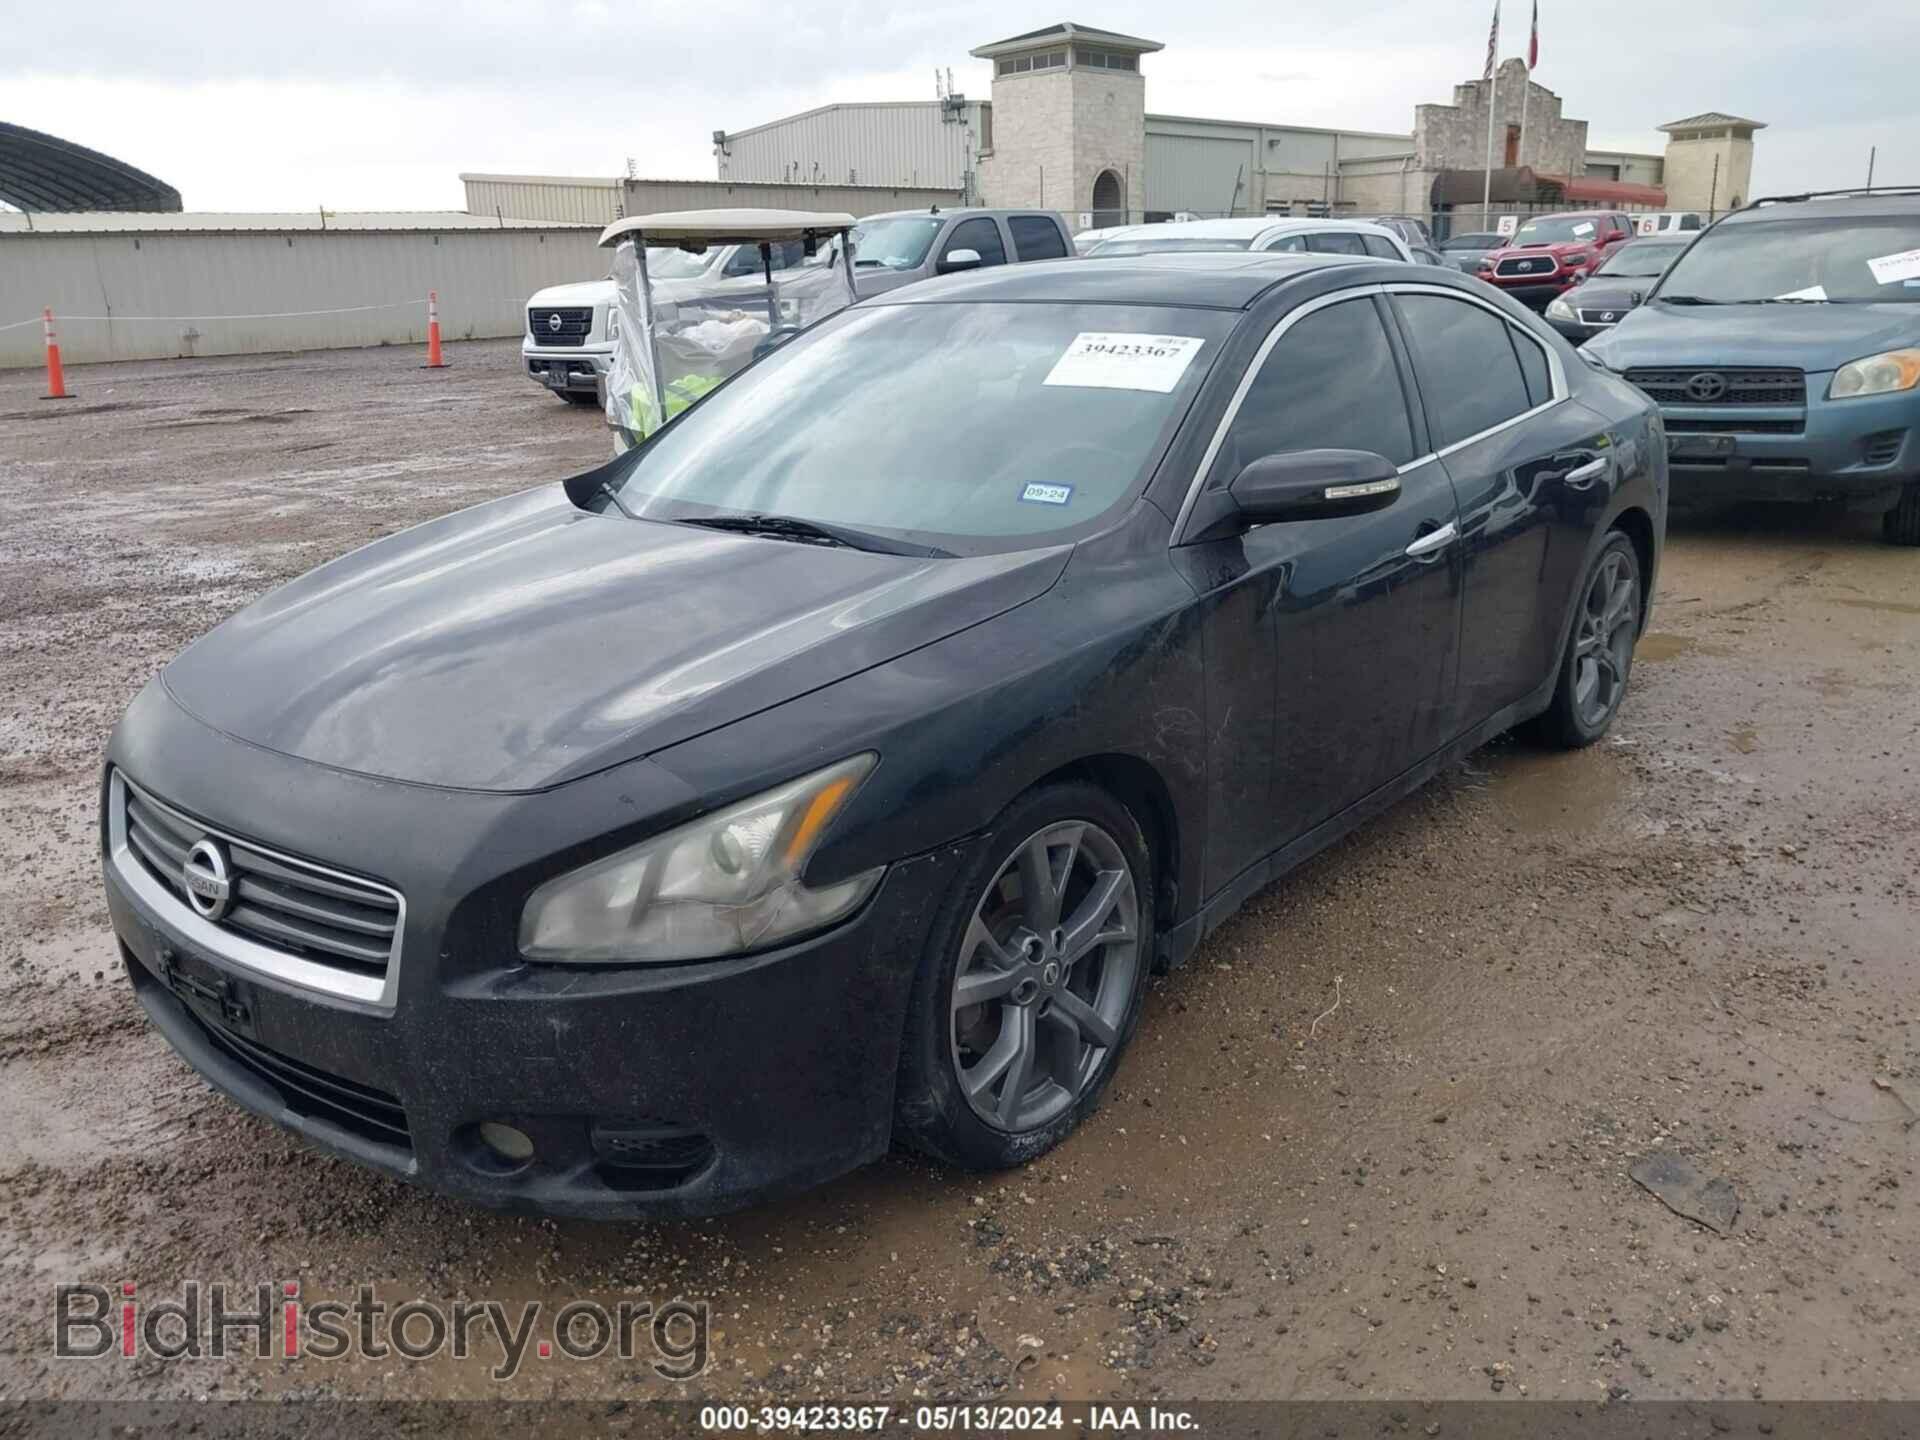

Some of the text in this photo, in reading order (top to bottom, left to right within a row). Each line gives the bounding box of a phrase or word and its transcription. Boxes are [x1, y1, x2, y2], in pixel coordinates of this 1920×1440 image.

[1503, 218, 1512, 232] 5
[1643, 219, 1653, 232] 6
[1080, 343, 1181, 358] 39423367
